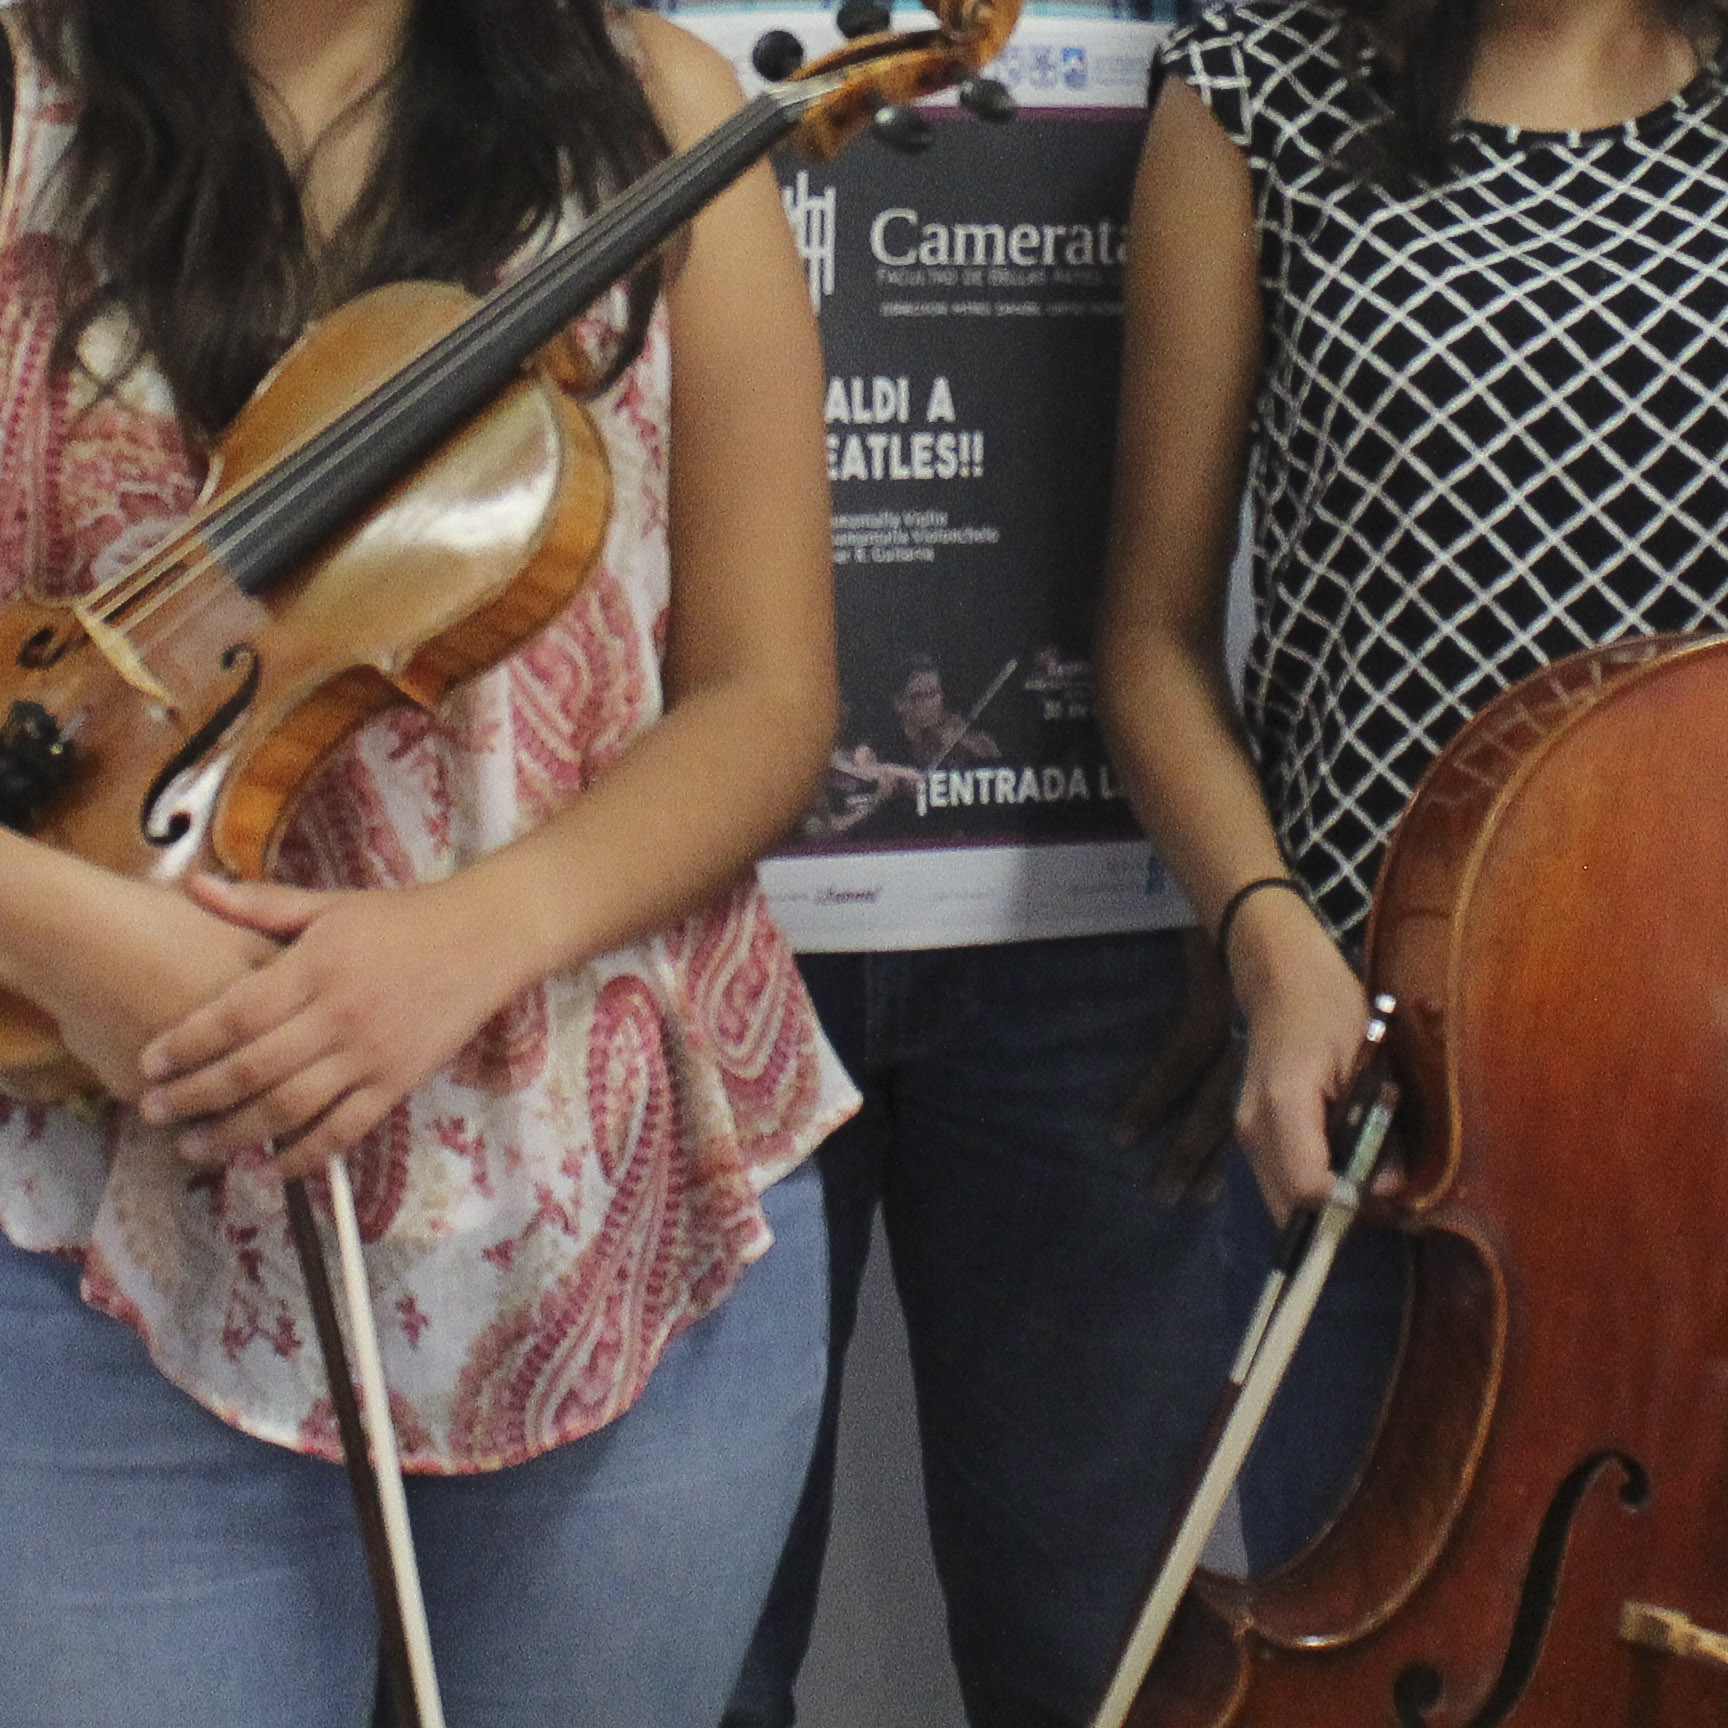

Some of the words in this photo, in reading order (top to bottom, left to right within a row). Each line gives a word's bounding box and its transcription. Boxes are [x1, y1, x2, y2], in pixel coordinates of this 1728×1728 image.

[869, 207, 1128, 266] Camerat
[824, 376, 911, 424] ALDI
[926, 375, 957, 423] A
[827, 430, 985, 480] EATLES!!
[916, 767, 1091, 817] ¡ENTRADA
